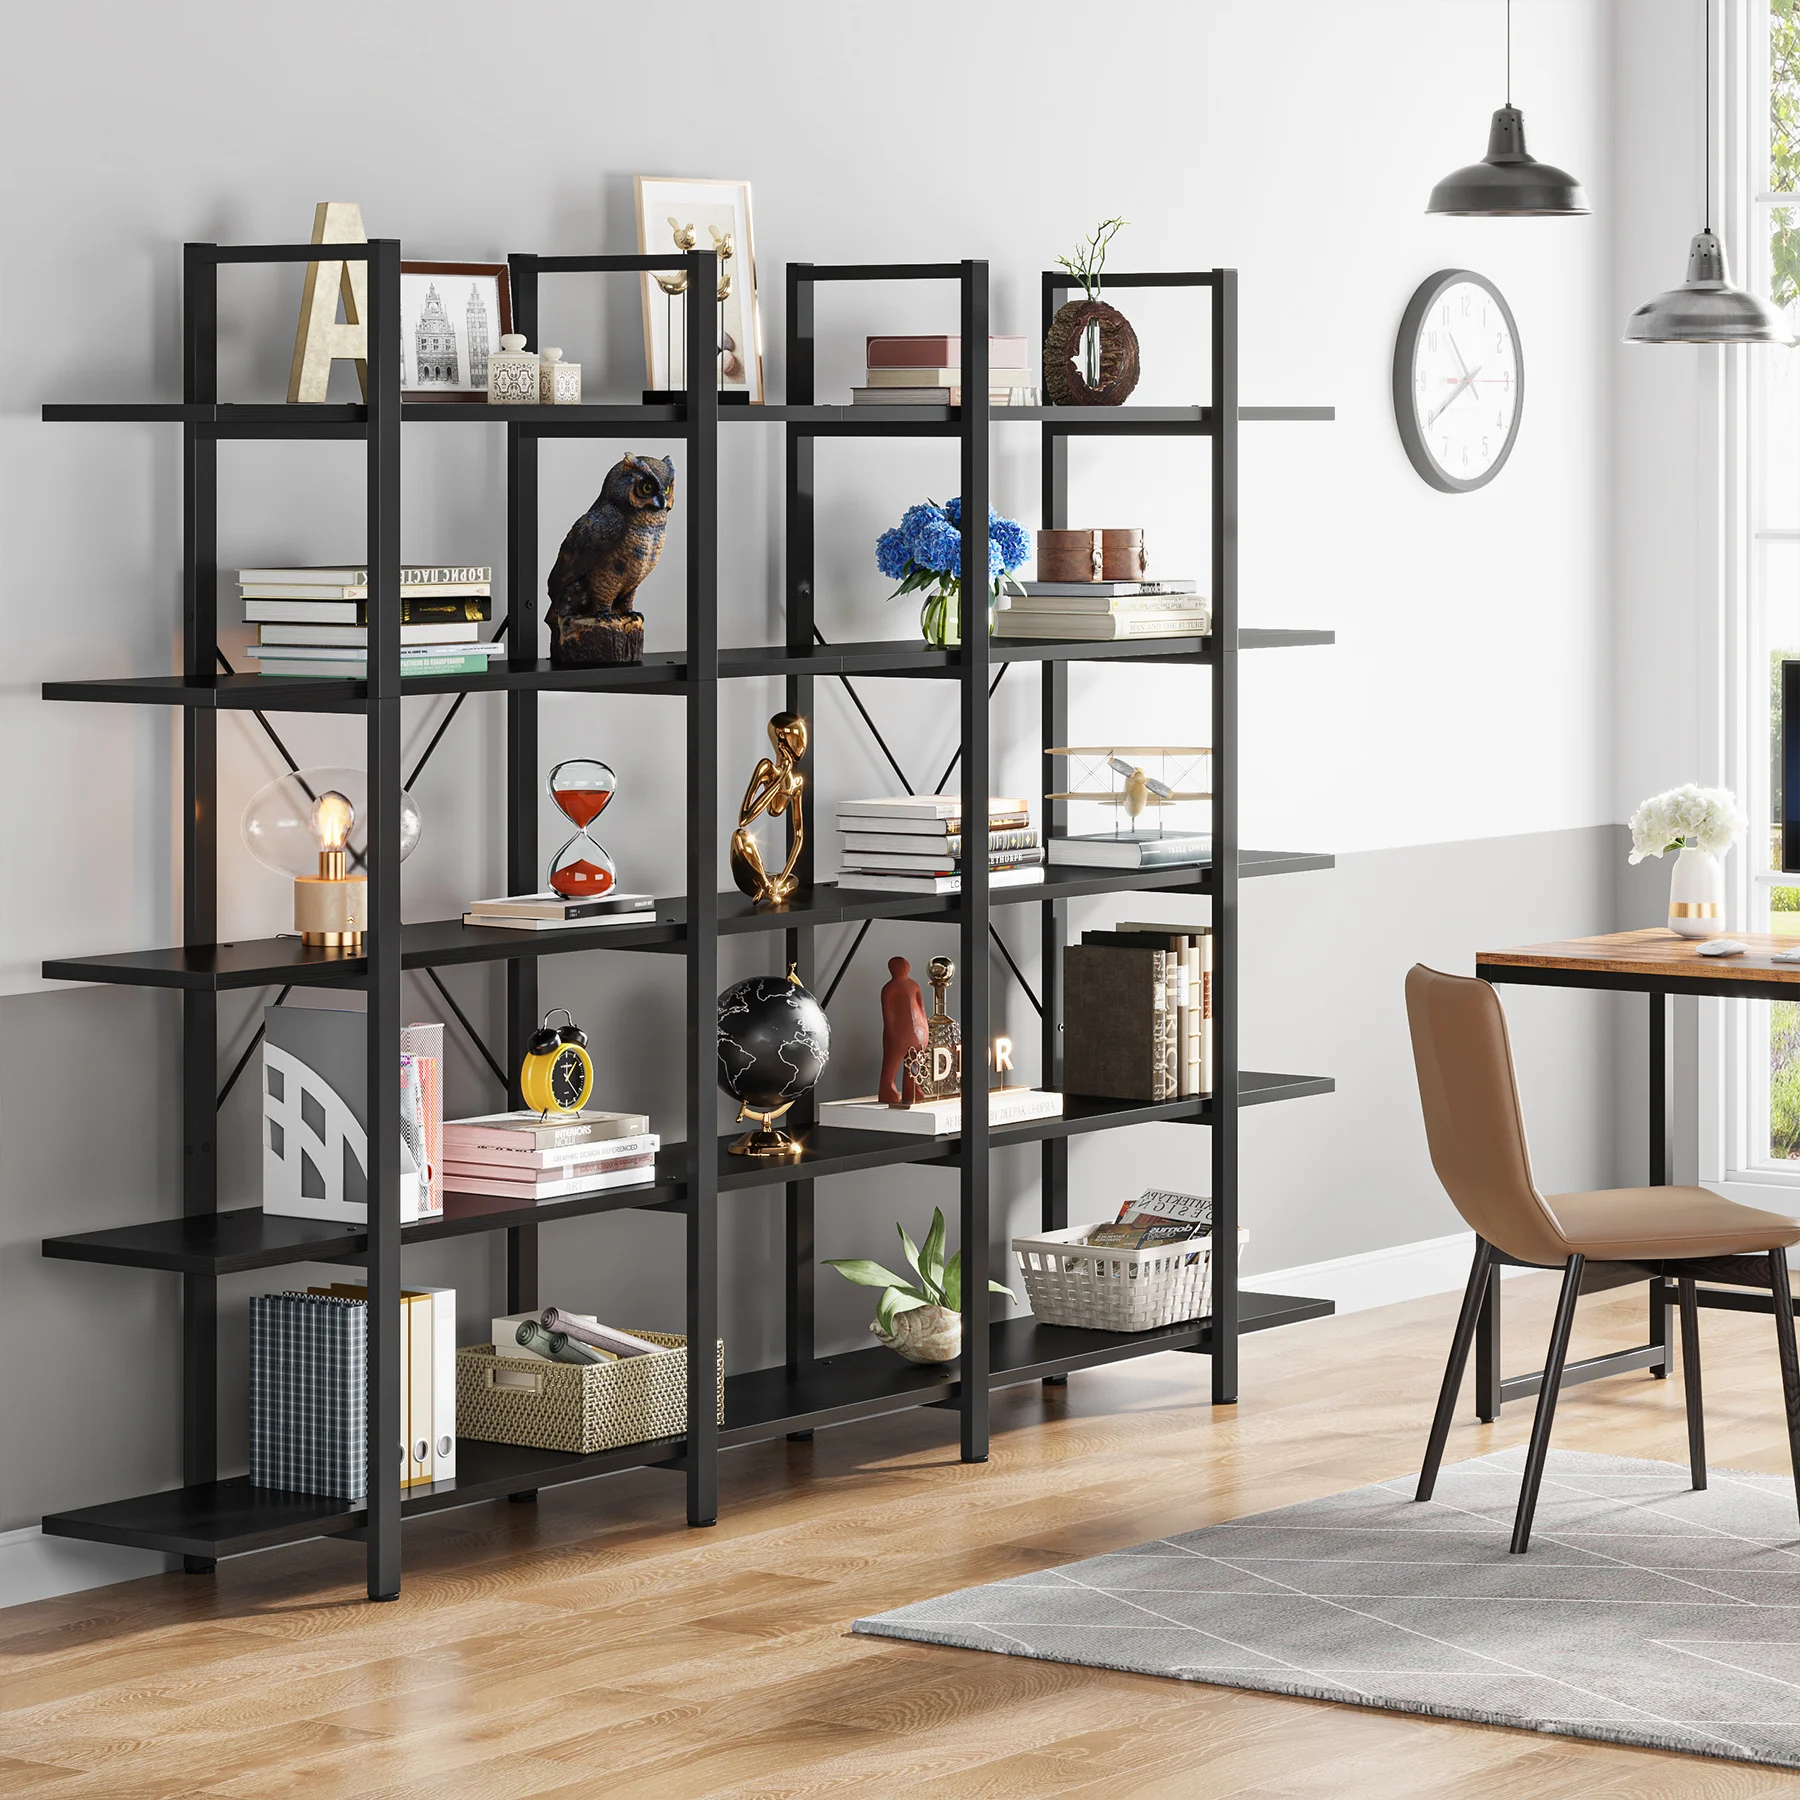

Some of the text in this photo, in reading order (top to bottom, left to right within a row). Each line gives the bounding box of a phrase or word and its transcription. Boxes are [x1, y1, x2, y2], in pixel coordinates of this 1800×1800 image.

[1443, 305, 1450, 327] 11
[1461, 295, 1470, 317] 12
[1483, 307, 1486, 327] 1
[1428, 331, 1438, 354] 10
[1496, 332, 1502, 354] 2
[1421, 370, 1426, 392] 9
[1504, 370, 1509, 392] 3
[1428, 409, 1434, 431] 8
[1496, 409, 1503, 430] 4
[1443, 436, 1450, 457] 7
[1463, 445, 1468, 467] 6
[1482, 436, 1488, 458] 5
[443, 567, 484, 582] БОРИС
[1129, 623, 1144, 631] MAN
[1178, 621, 1205, 629] FUTURE
[933, 1038, 1015, 1082] DIR
[990, 1110, 999, 1120] BY
[1000, 1105, 1028, 1119] DEEPAK
[1028, 1101, 1056, 1115] CHOPRA
[554, 1125, 592, 1139] INTERIORS
[554, 1144, 638, 1162] GRAPHIC DESIGN REFERENCED
